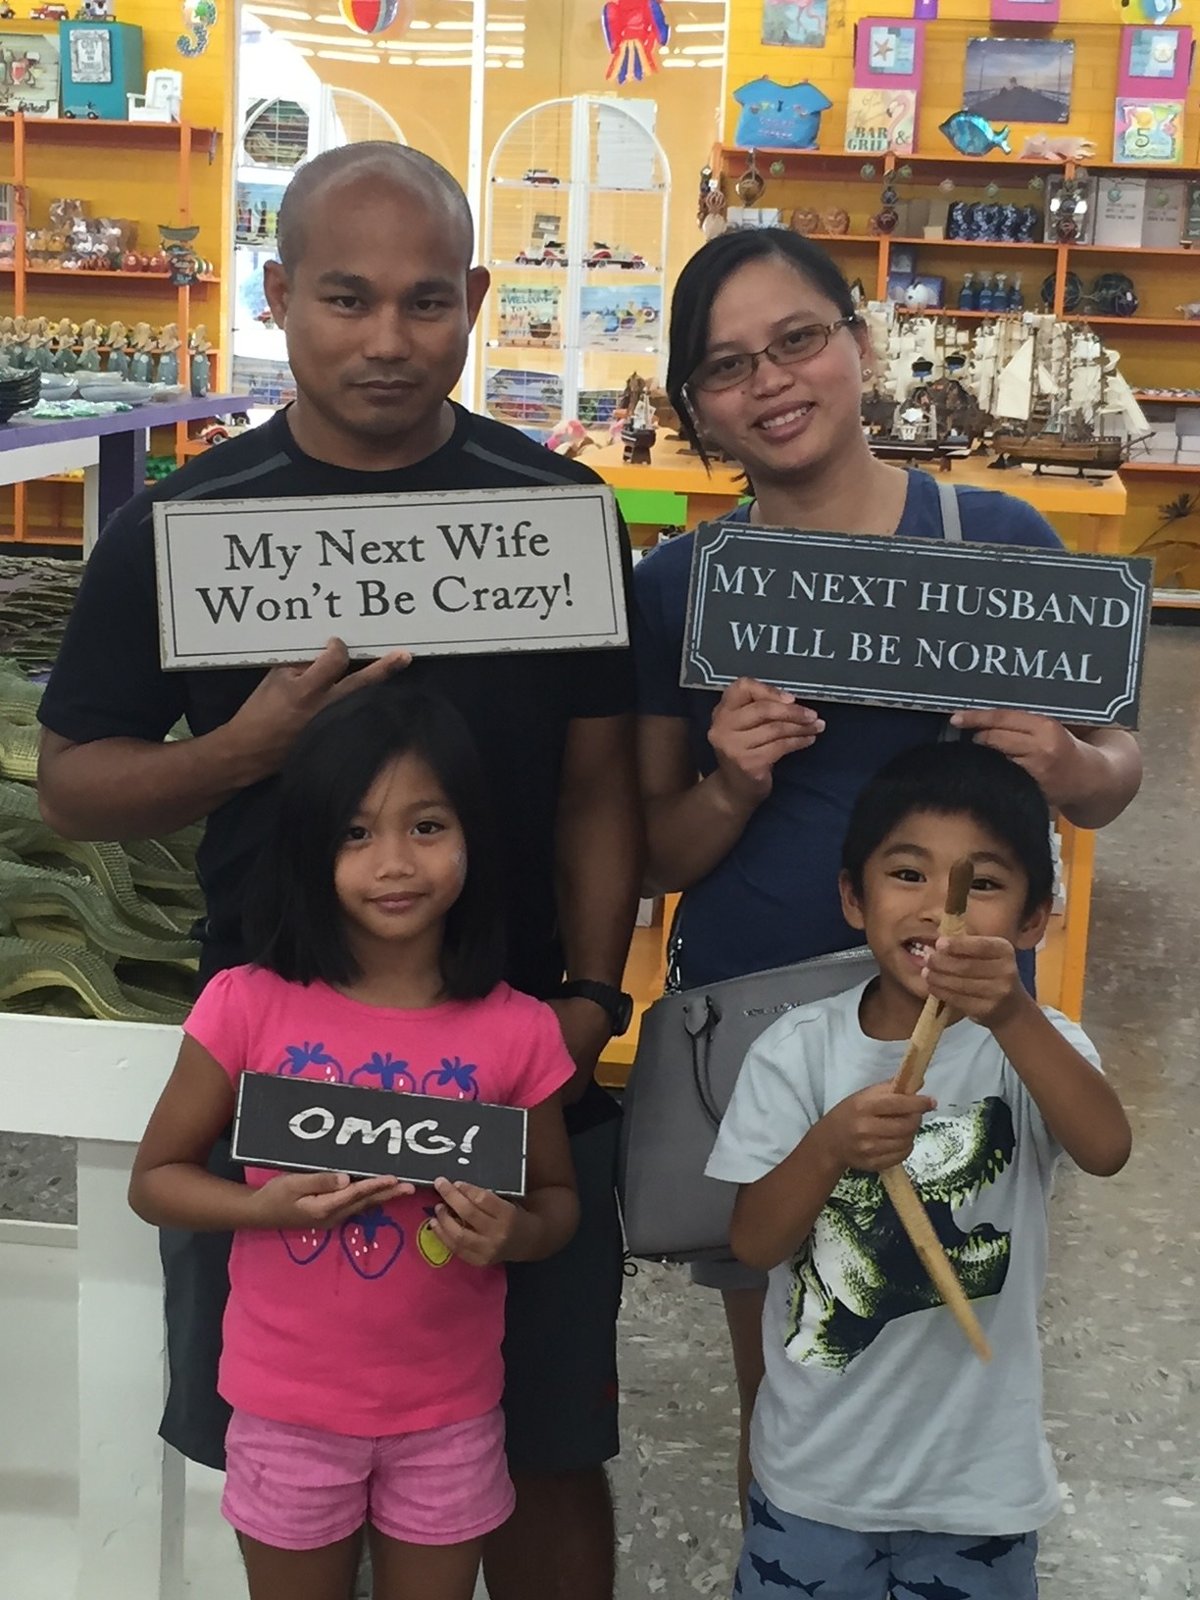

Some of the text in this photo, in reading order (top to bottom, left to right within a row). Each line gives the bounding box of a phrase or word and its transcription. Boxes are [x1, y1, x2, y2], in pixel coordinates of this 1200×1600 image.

[855, 127, 888, 139] BAR
[1134, 127, 1151, 148] 5
[223, 520, 550, 581] My Next Wife
[194, 572, 575, 625] Won't Be Crazy!
[711, 563, 1131, 628] MY NEXT HUSBAND
[729, 621, 1102, 684] WILL BE NORMAL
[288, 1106, 480, 1165] OMG!
